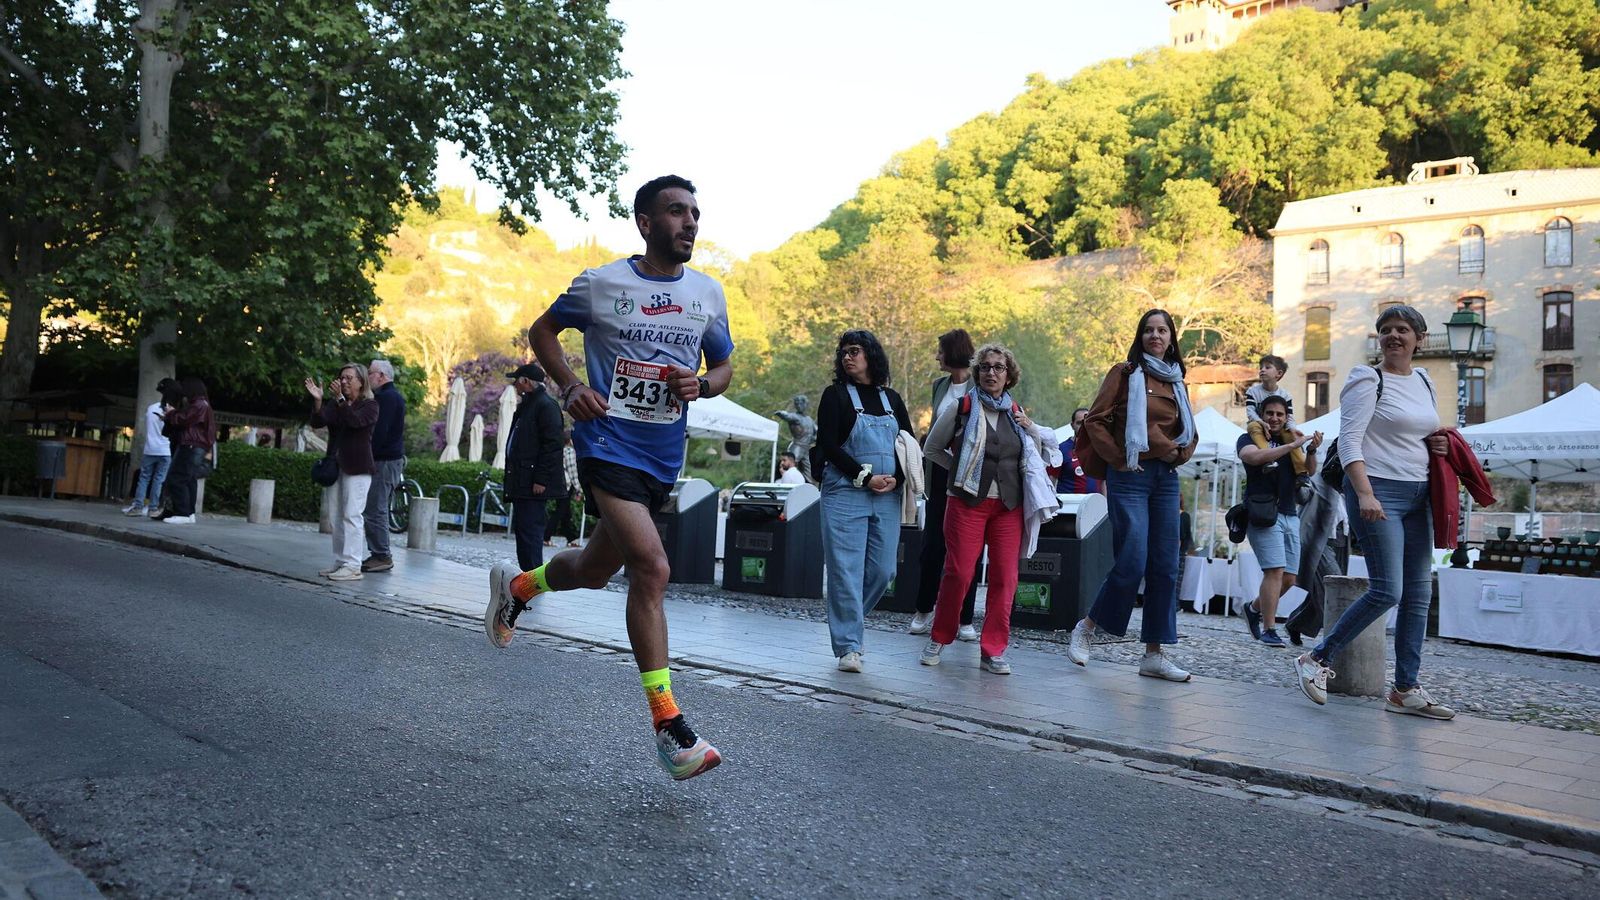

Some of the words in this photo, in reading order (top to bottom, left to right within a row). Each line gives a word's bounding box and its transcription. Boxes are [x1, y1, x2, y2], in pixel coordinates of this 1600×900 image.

[650, 293, 672, 309] 35
[658, 324, 695, 333] ATLETISMO
[618, 328, 699, 347] MARACENA
[617, 361, 630, 375] 41
[630, 364, 643, 372] MEDIA
[613, 376, 672, 406] 3431
[1027, 561, 1054, 571] RESTO
